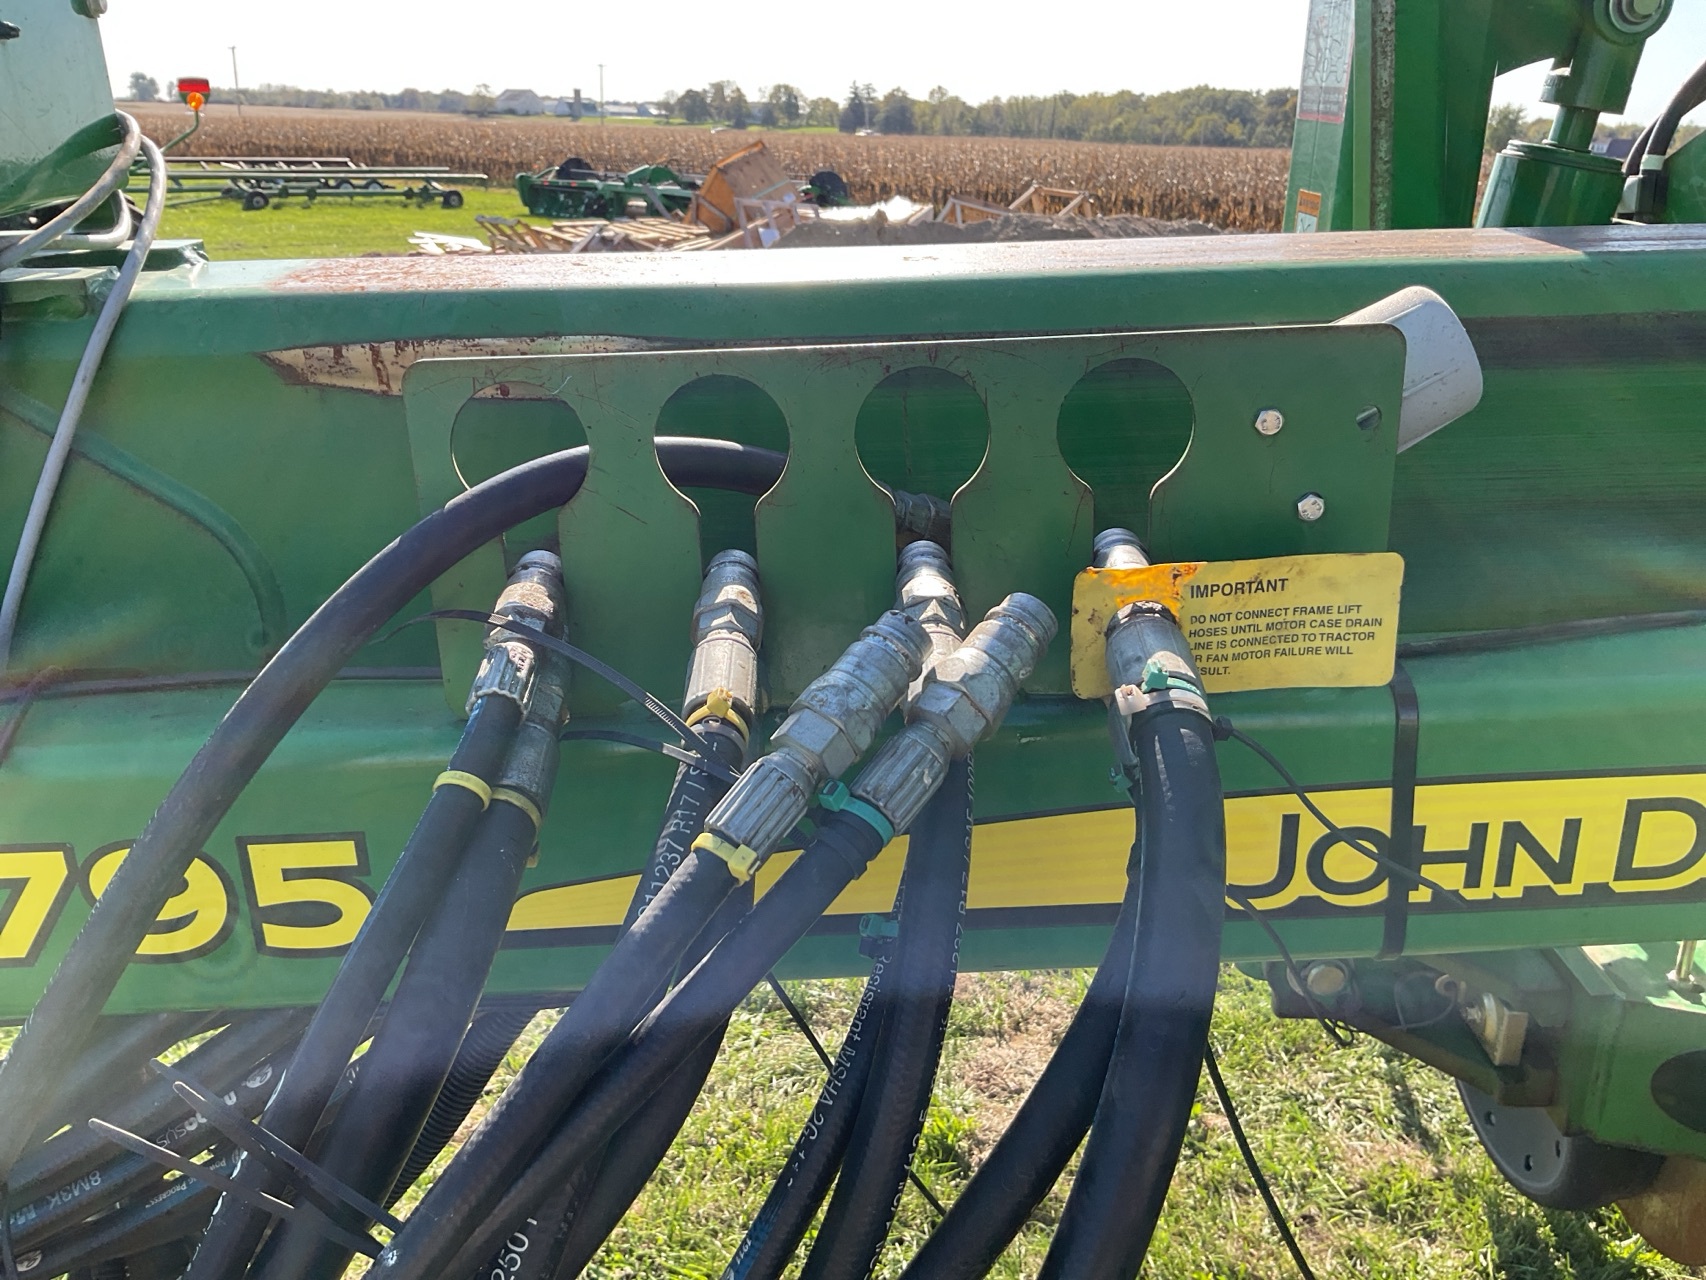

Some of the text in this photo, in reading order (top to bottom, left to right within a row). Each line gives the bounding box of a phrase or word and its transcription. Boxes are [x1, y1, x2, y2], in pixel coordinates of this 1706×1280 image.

[1190, 578, 1288, 598] IMPORTANT
[1188, 617, 1382, 638] HOSES UNTIL MOTOR CASE DRAIN
[1190, 604, 1362, 625] DO NOT CONNECT FRAME LIFT
[1194, 645, 1353, 663] R FAN MOTOR FAILURE WILL
[1216, 640, 1227, 650] IS
[1230, 633, 1299, 648] CONNECTED
[1301, 632, 1316, 643] TO
[1319, 631, 1375, 642] TRACTOR
[670, 794, 701, 834] R17
[1226, 814, 1583, 899] JOHN
[0, 833, 374, 963] 795
[819, 1044, 857, 1106] MSHA
[46, 1170, 102, 1210] 8M3K
